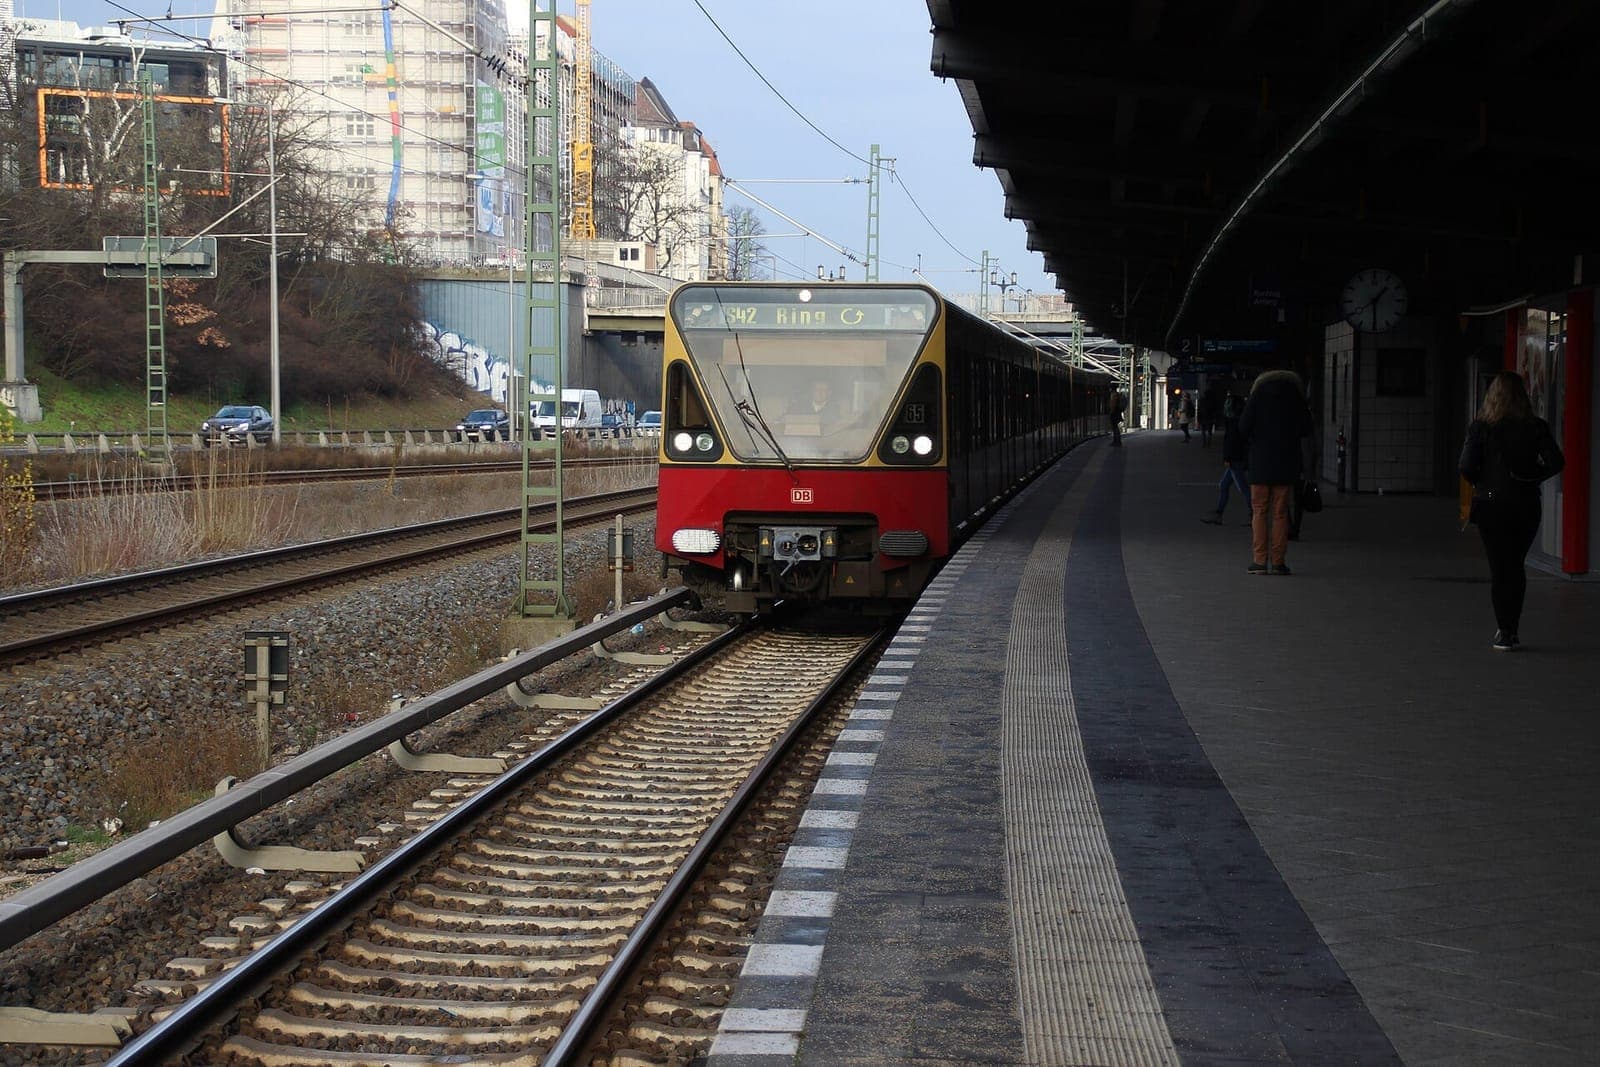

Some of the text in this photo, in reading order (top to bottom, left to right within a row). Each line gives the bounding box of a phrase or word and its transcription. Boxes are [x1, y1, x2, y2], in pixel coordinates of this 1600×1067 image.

[725, 306, 826, 325] S42 Ring
[1181, 338, 1191, 353] 2
[793, 490, 811, 501] DB
